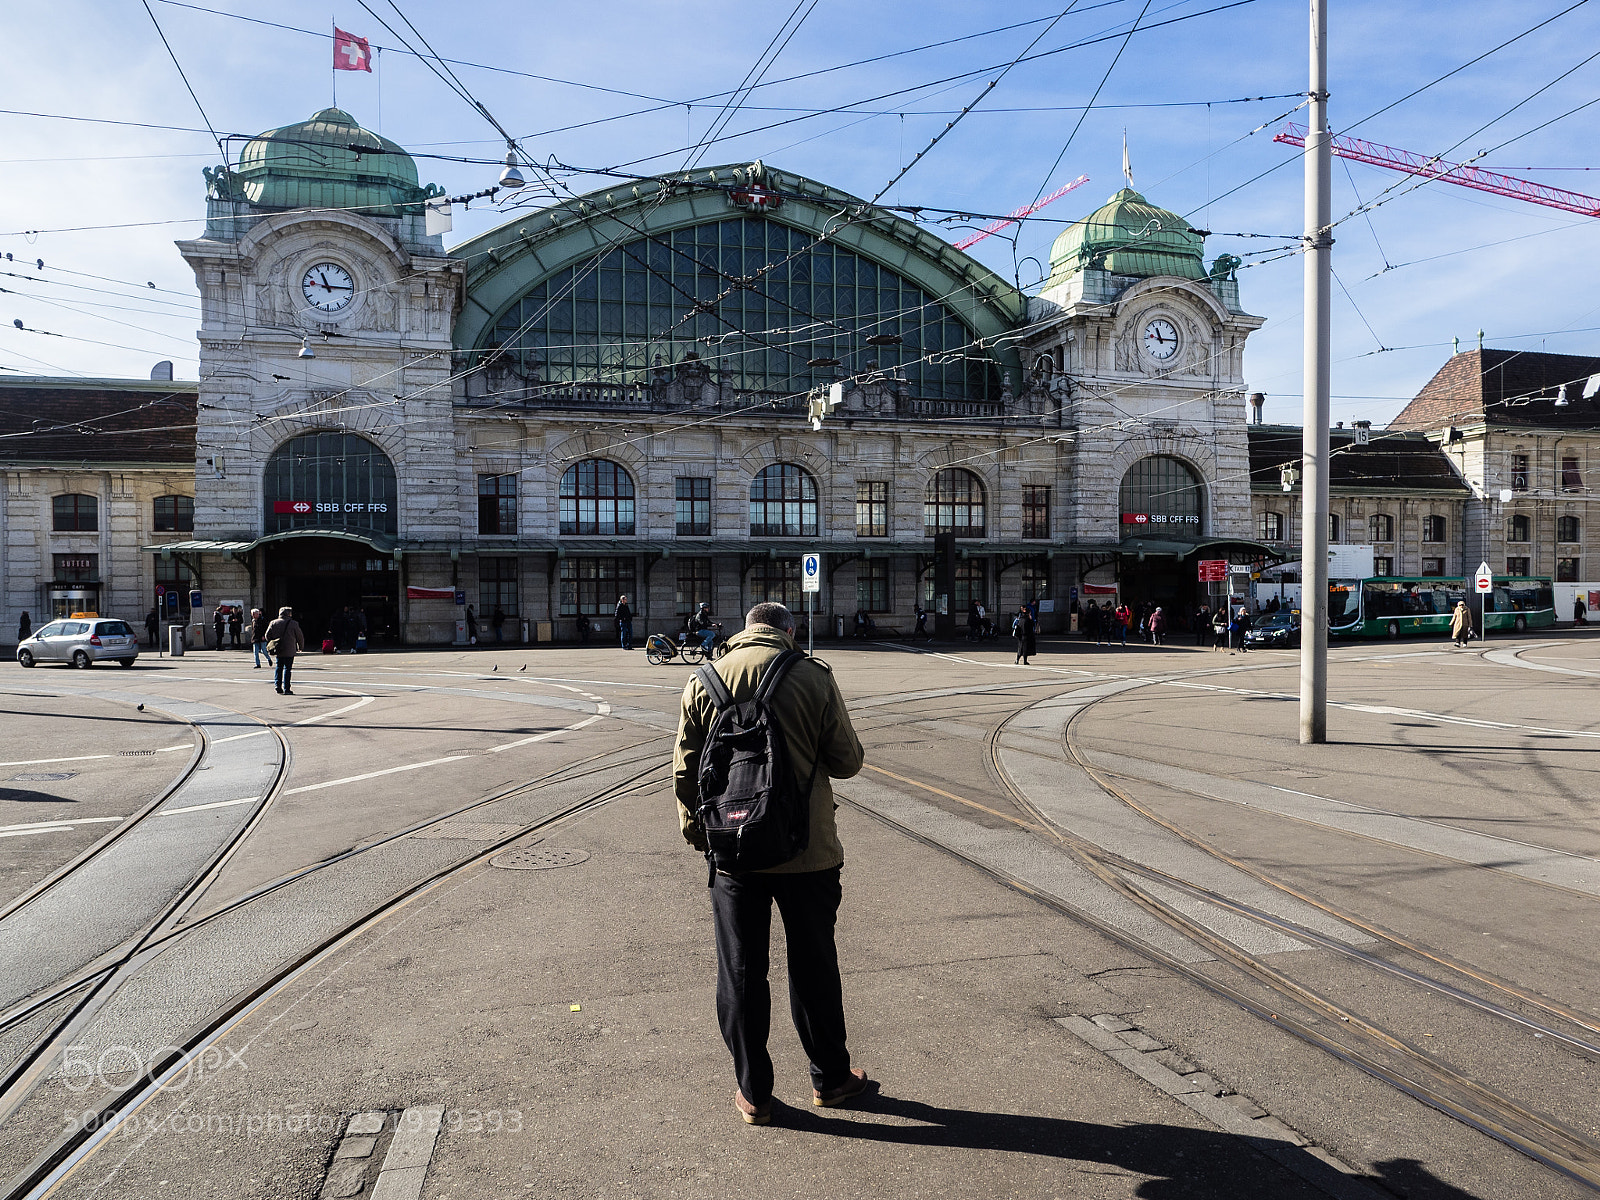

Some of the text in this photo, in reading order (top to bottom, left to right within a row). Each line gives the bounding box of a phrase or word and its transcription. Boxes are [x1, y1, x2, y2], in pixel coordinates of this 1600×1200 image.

[1358, 431, 1367, 442] 15
[315, 502, 388, 513] SBB CFF FFS
[1150, 514, 1199, 524] SBB CFF FFS
